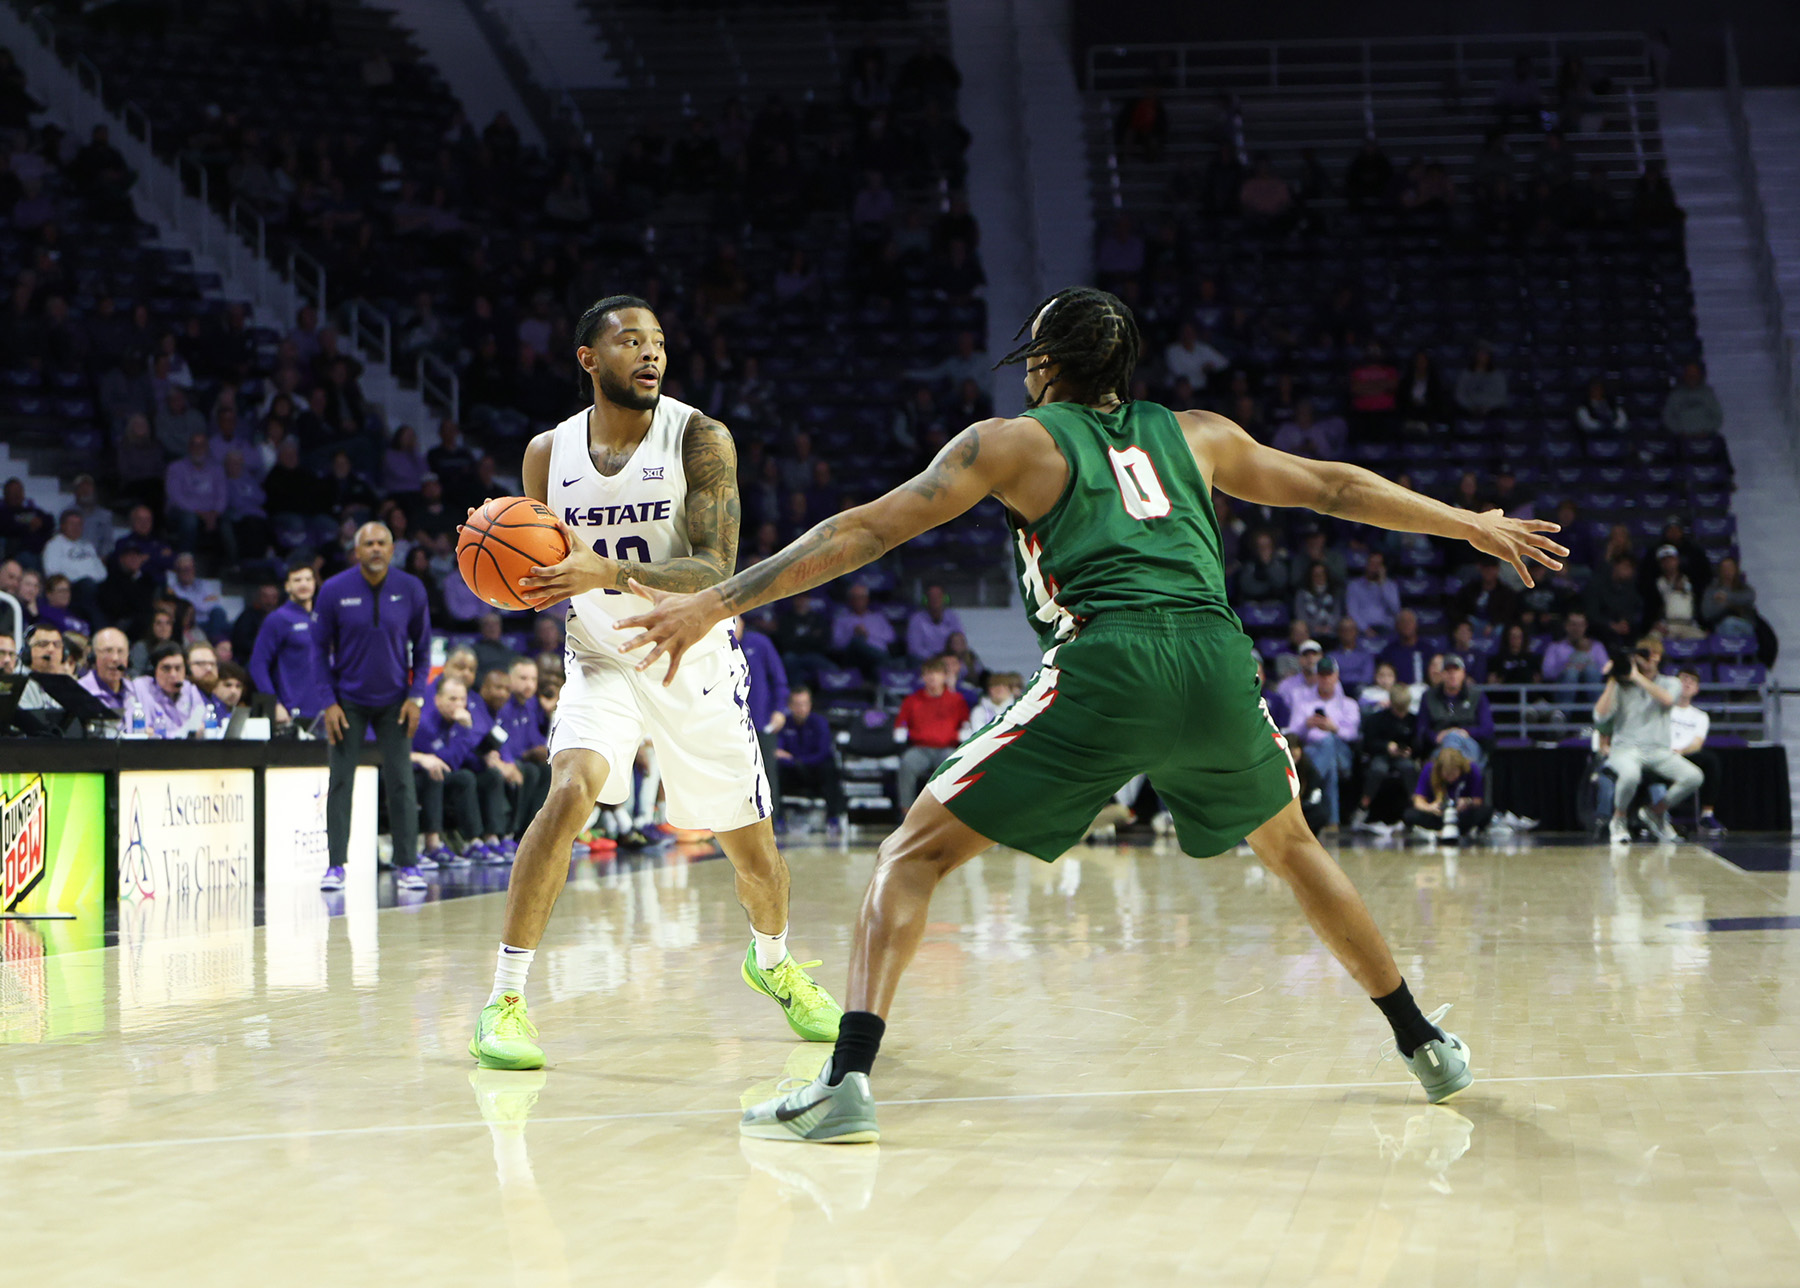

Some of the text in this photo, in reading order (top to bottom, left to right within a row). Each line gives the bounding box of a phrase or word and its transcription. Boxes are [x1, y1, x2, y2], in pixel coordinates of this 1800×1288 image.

[1108, 444, 1172, 520] 0
[564, 500, 671, 526] K-STATE
[162, 780, 244, 826] Ascension
[162, 843, 248, 892] Via Christi
